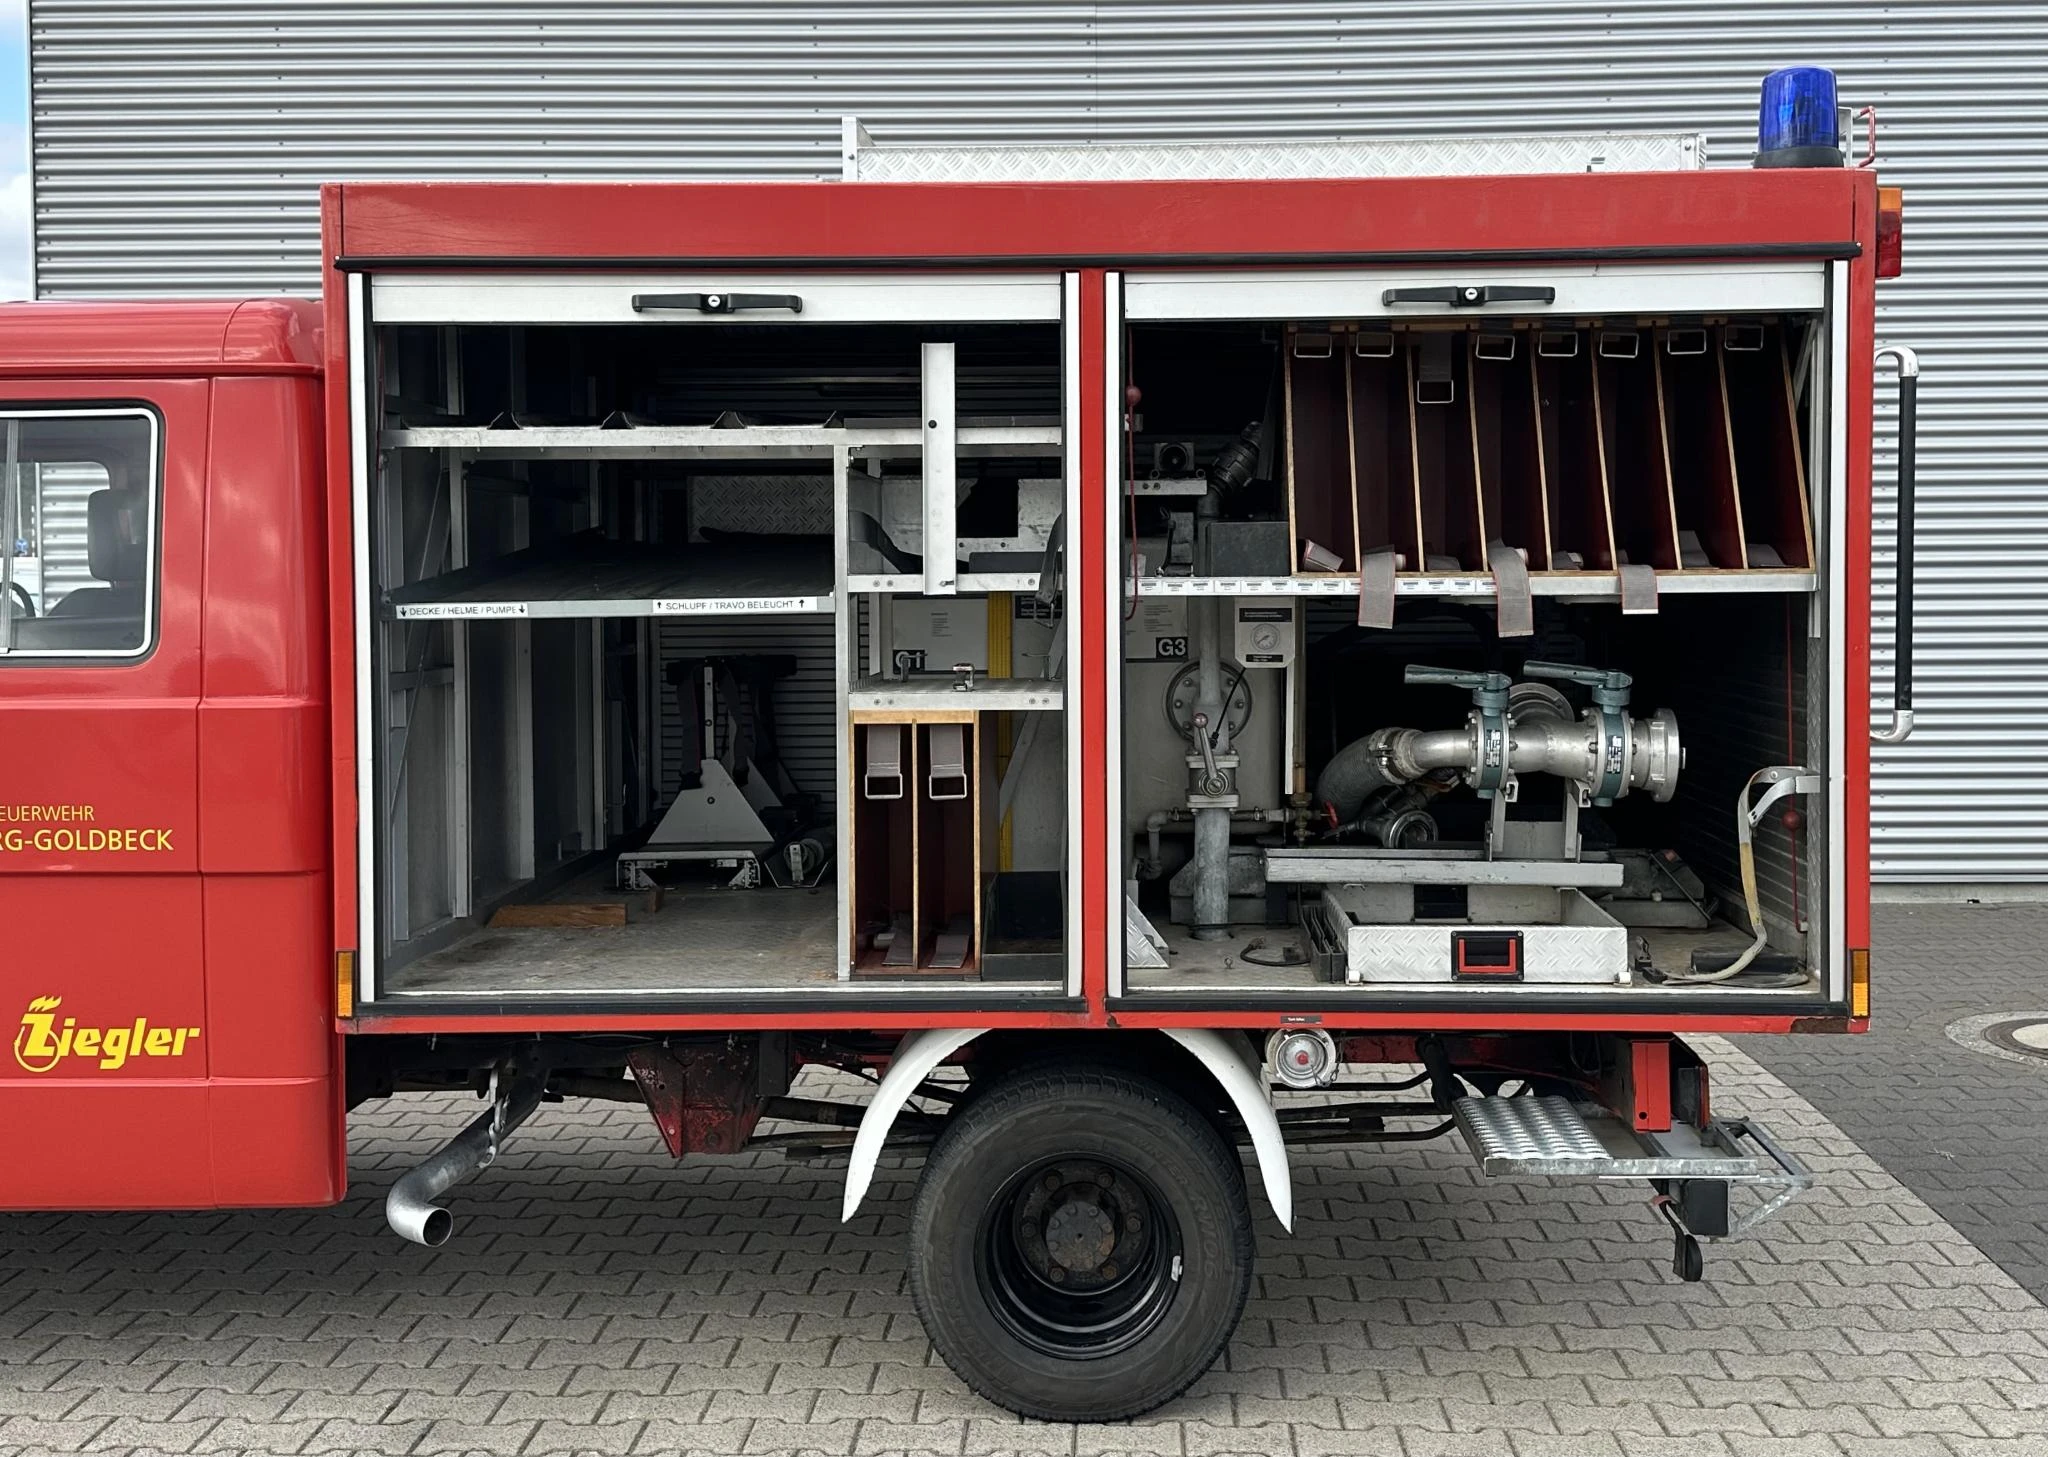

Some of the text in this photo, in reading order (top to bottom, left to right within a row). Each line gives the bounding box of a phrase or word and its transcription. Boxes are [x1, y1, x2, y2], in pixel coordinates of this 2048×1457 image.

[409, 607, 440, 616] DECKE
[447, 606, 479, 616] HELME
[665, 601, 707, 611] SCHLUPF
[714, 600, 746, 610] TRAVO
[747, 599, 794, 609] BELEUCHT
[1158, 638, 1187, 656] G3
[0, 829, 174, 851] G-GOLDBECK
[17, 1003, 200, 1071] Ziegler
